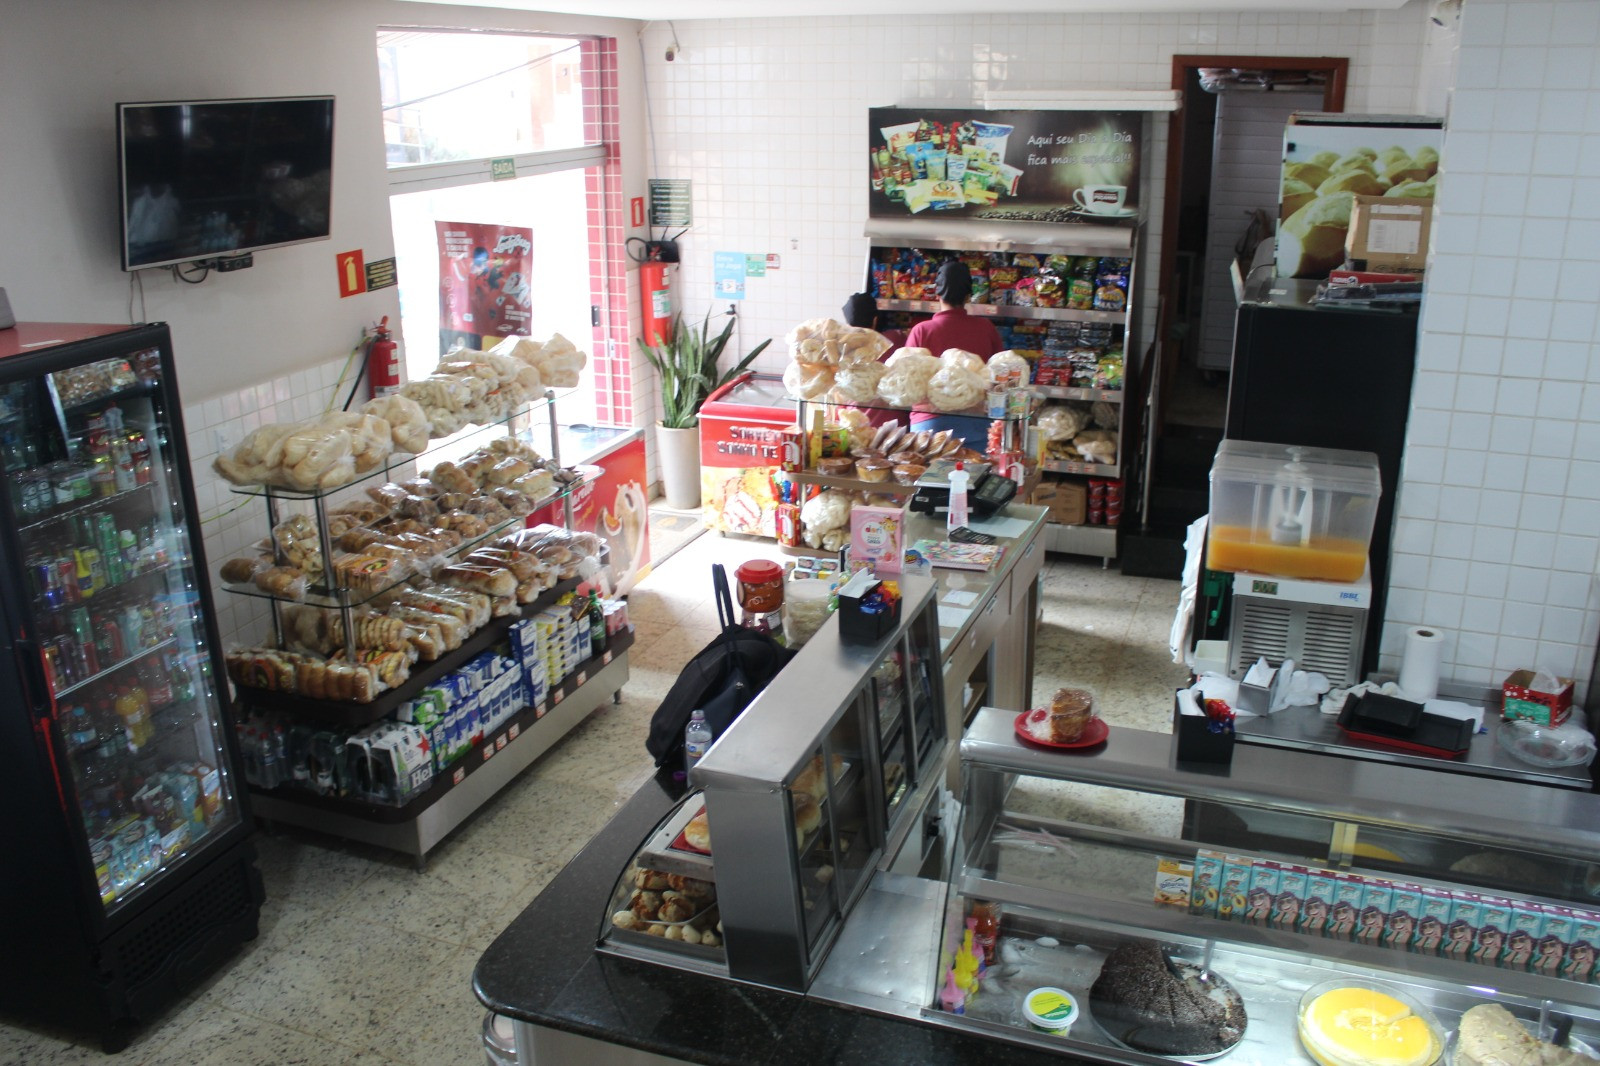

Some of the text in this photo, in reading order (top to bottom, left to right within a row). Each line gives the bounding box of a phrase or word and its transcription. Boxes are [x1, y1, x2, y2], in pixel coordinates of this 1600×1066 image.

[1027, 134, 1053, 147] Aqui
[1056, 135, 1073, 144] seu
[1079, 133, 1096, 143] Dia
[1113, 132, 1132, 143] Dia
[1027, 154, 1047, 165] fica
[1051, 155, 1076, 164] mais
[411, 762, 434, 788] Hei
